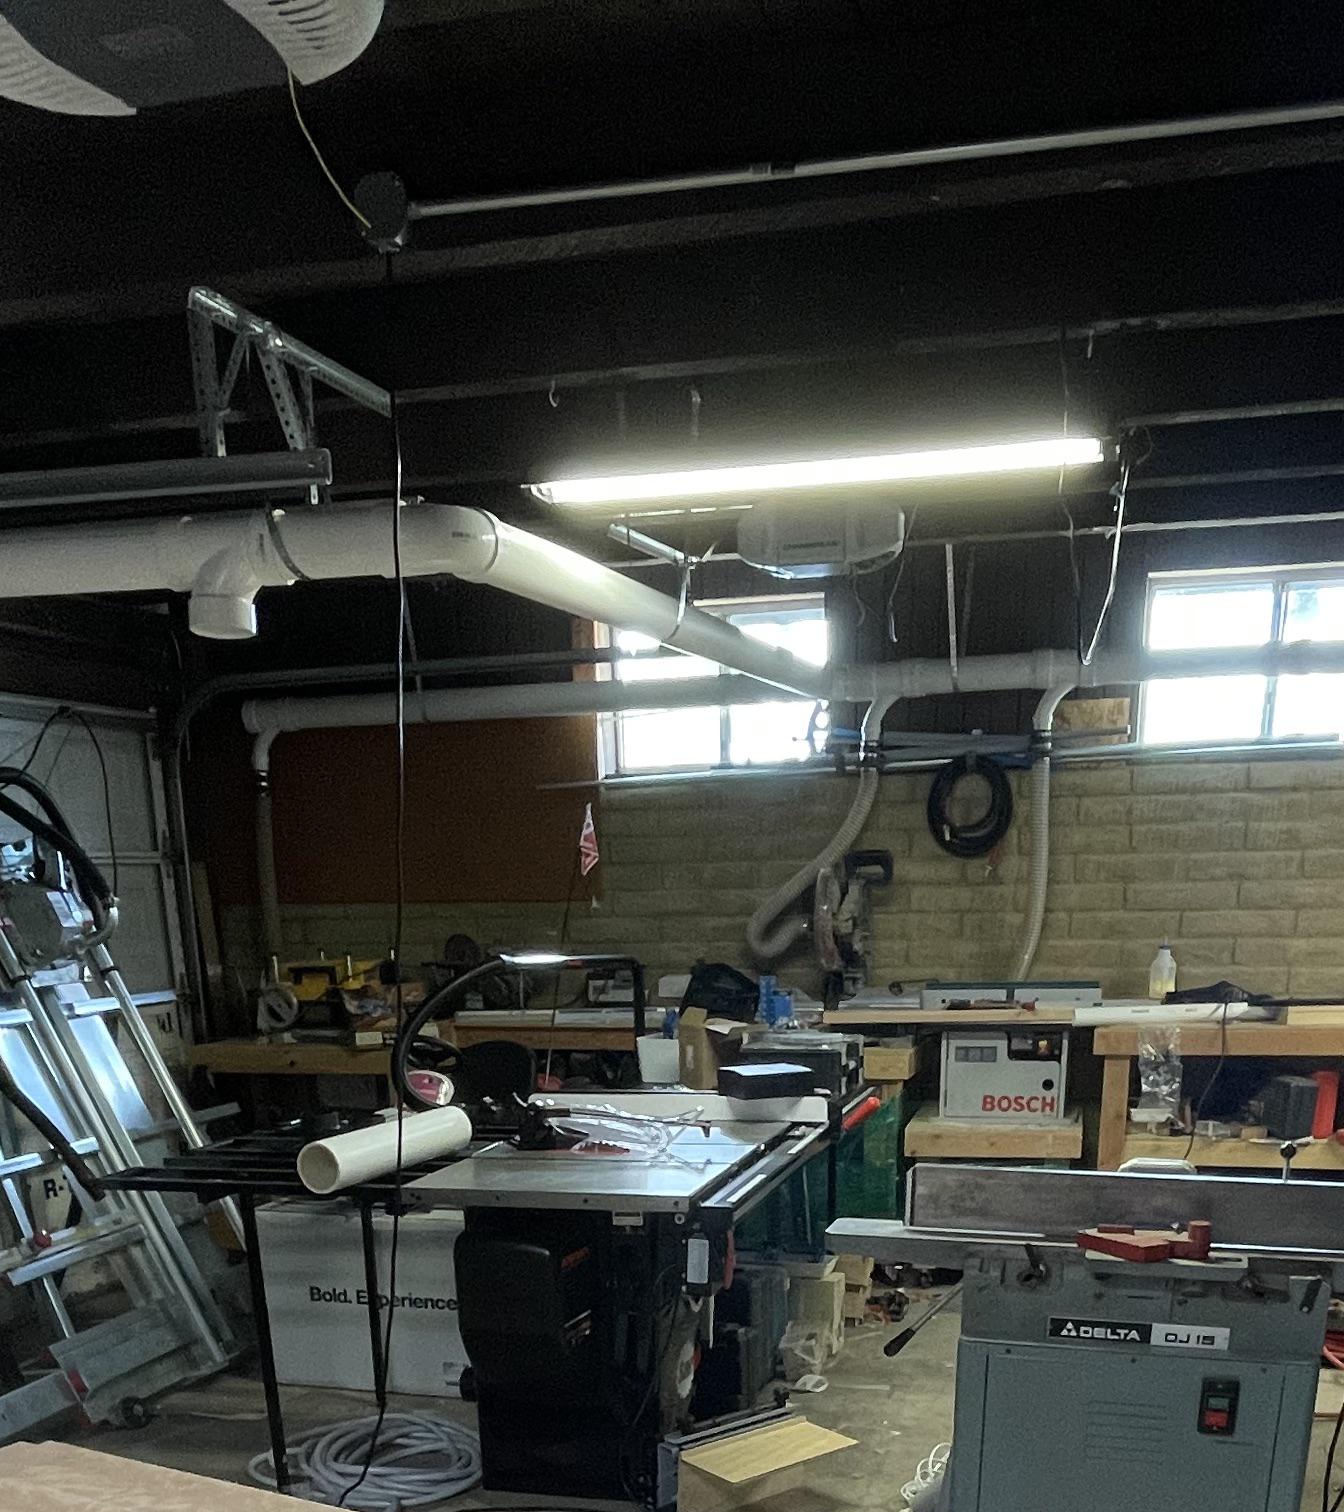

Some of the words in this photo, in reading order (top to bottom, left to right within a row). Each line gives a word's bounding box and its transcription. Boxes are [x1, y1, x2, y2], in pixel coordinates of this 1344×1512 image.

[980, 1094, 1056, 1114] BOSCH
[309, 1285, 353, 1305] Bold.
[356, 1288, 457, 1311] Eperience
[1078, 1325, 1142, 1342] DELTA
[1163, 1332, 1191, 1345] DJ
